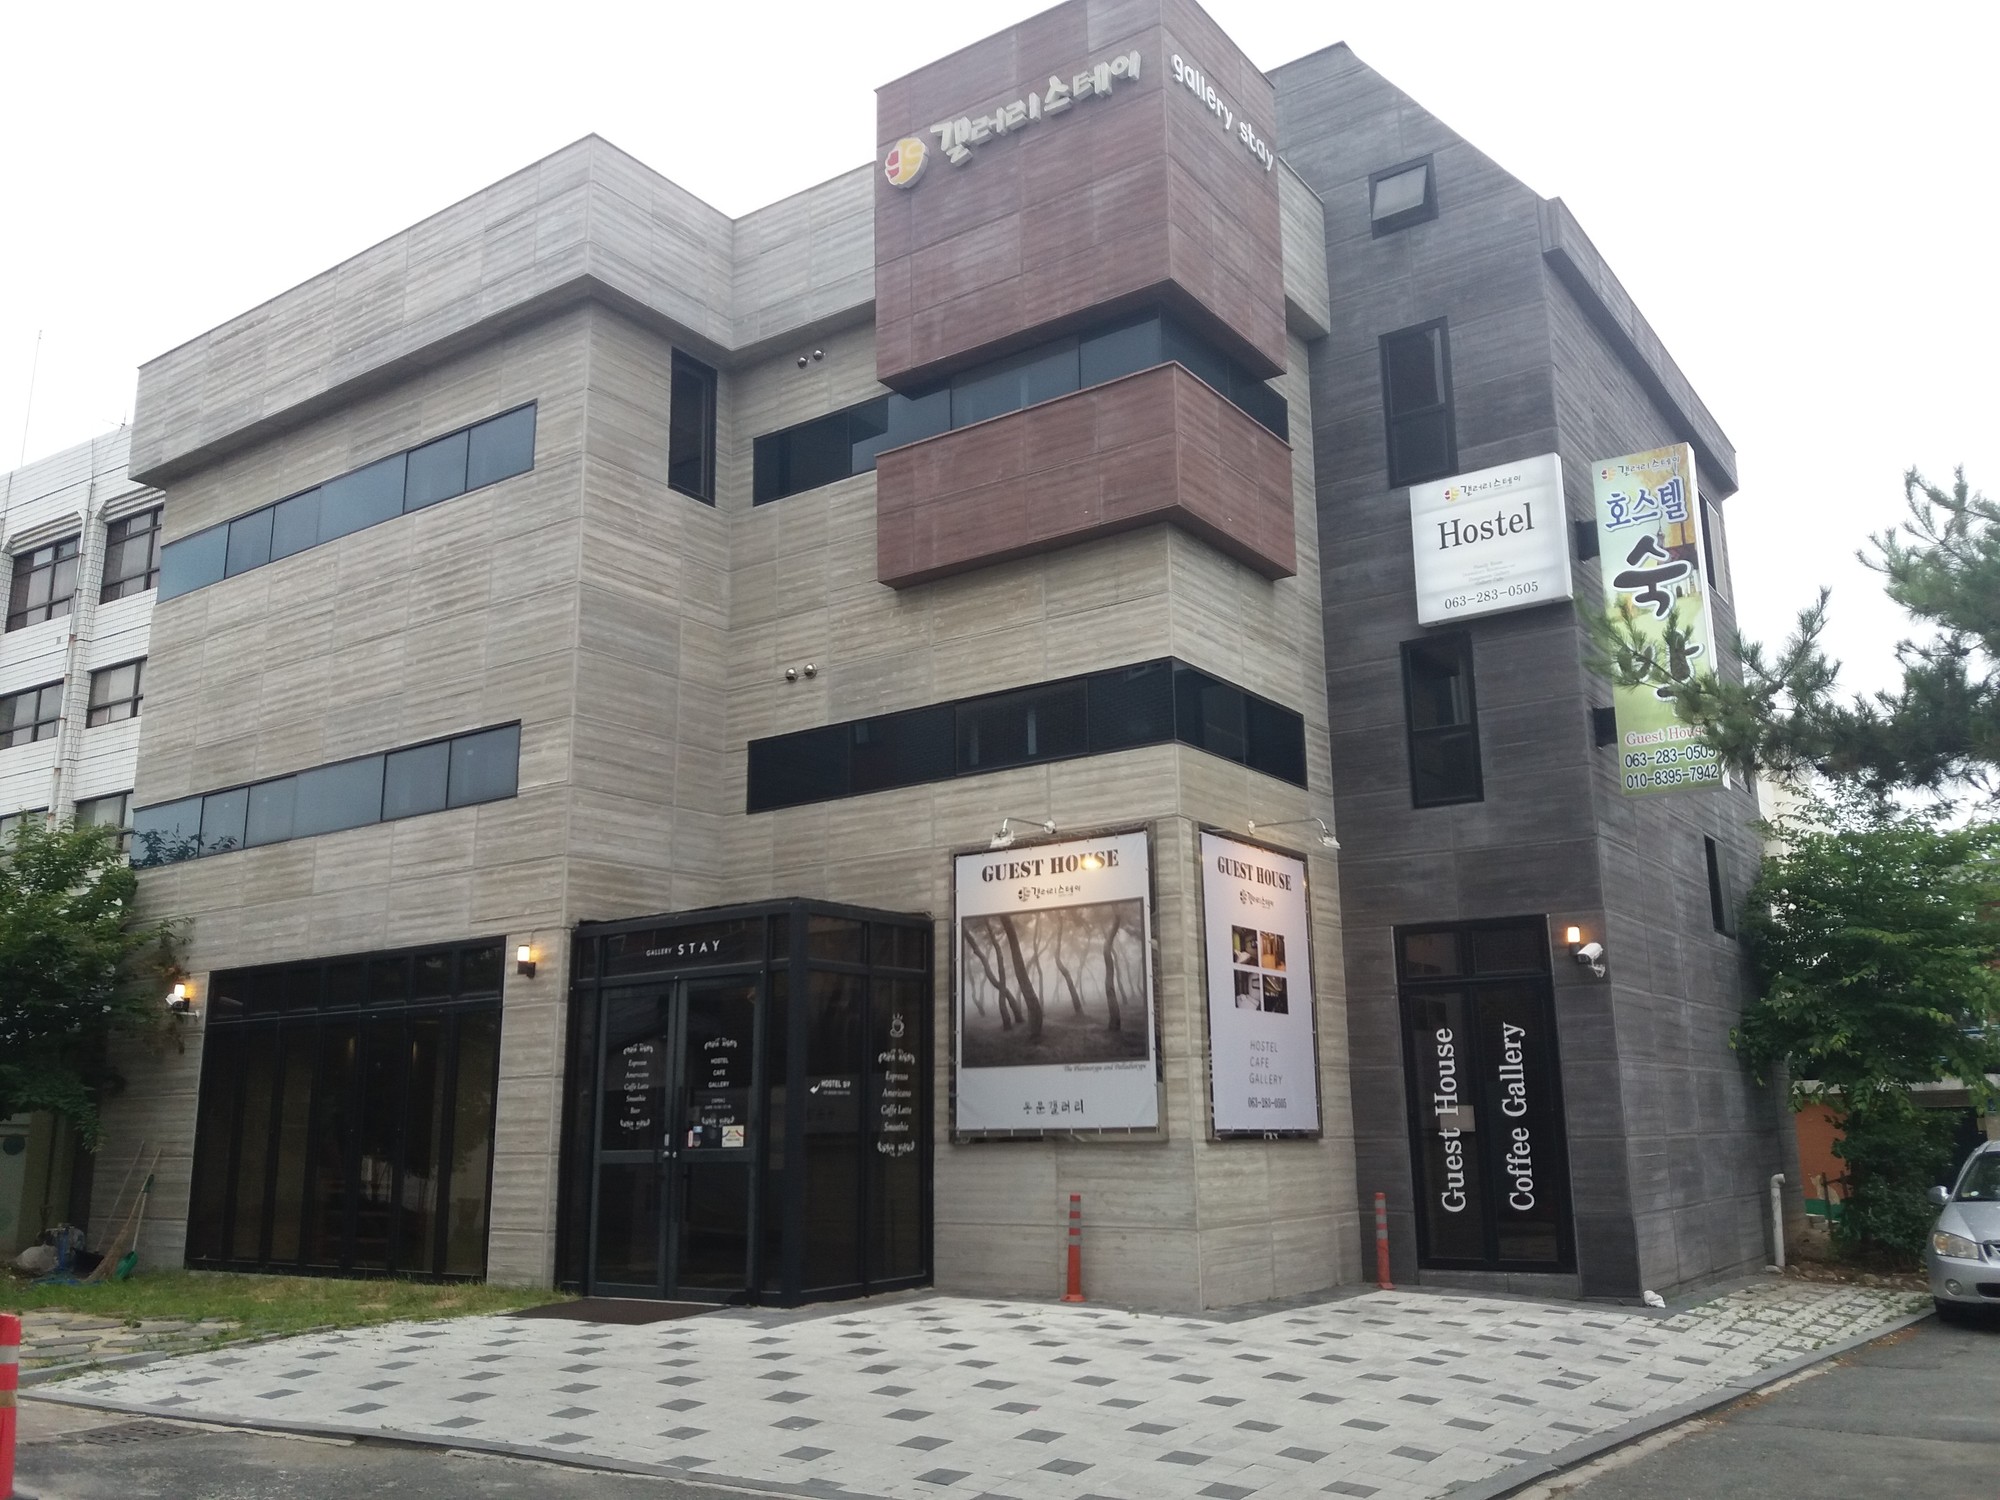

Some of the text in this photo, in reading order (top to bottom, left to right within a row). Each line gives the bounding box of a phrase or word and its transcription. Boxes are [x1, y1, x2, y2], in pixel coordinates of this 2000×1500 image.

[930, 50, 1142, 166] 갤러리스테이
[1170, 53, 1274, 172] gallery stay
[1617, 456, 1680, 476] 갤러리스테이
[1460, 475, 1521, 496] 갤러리스테이
[1605, 479, 1685, 530] 호스텔
[1437, 502, 1535, 550] Hostel
[1444, 581, 1539, 609] 063-283-0505
[1626, 730, 1664, 746] Guest
[1625, 744, 1716, 768] 063-283-0505
[1626, 764, 1719, 789] 010-8395-7942
[981, 859, 1044, 882] GUEST
[1217, 855, 1292, 891] GUEST HOUSE
[646, 939, 721, 957] GALLERY STAY
[1250, 1040, 1278, 1053] HOSTEL
[712, 1068, 726, 1077] CAFE
[1249, 1056, 1269, 1068] CAFE
[708, 1080, 730, 1089] GALLERY
[1249, 1072, 1283, 1085] GALLERY
[882, 1087, 911, 1098] Americano
[1434, 1027, 1466, 1213] Guest House
[1498, 1021, 1535, 1211] Coffee Gallery
